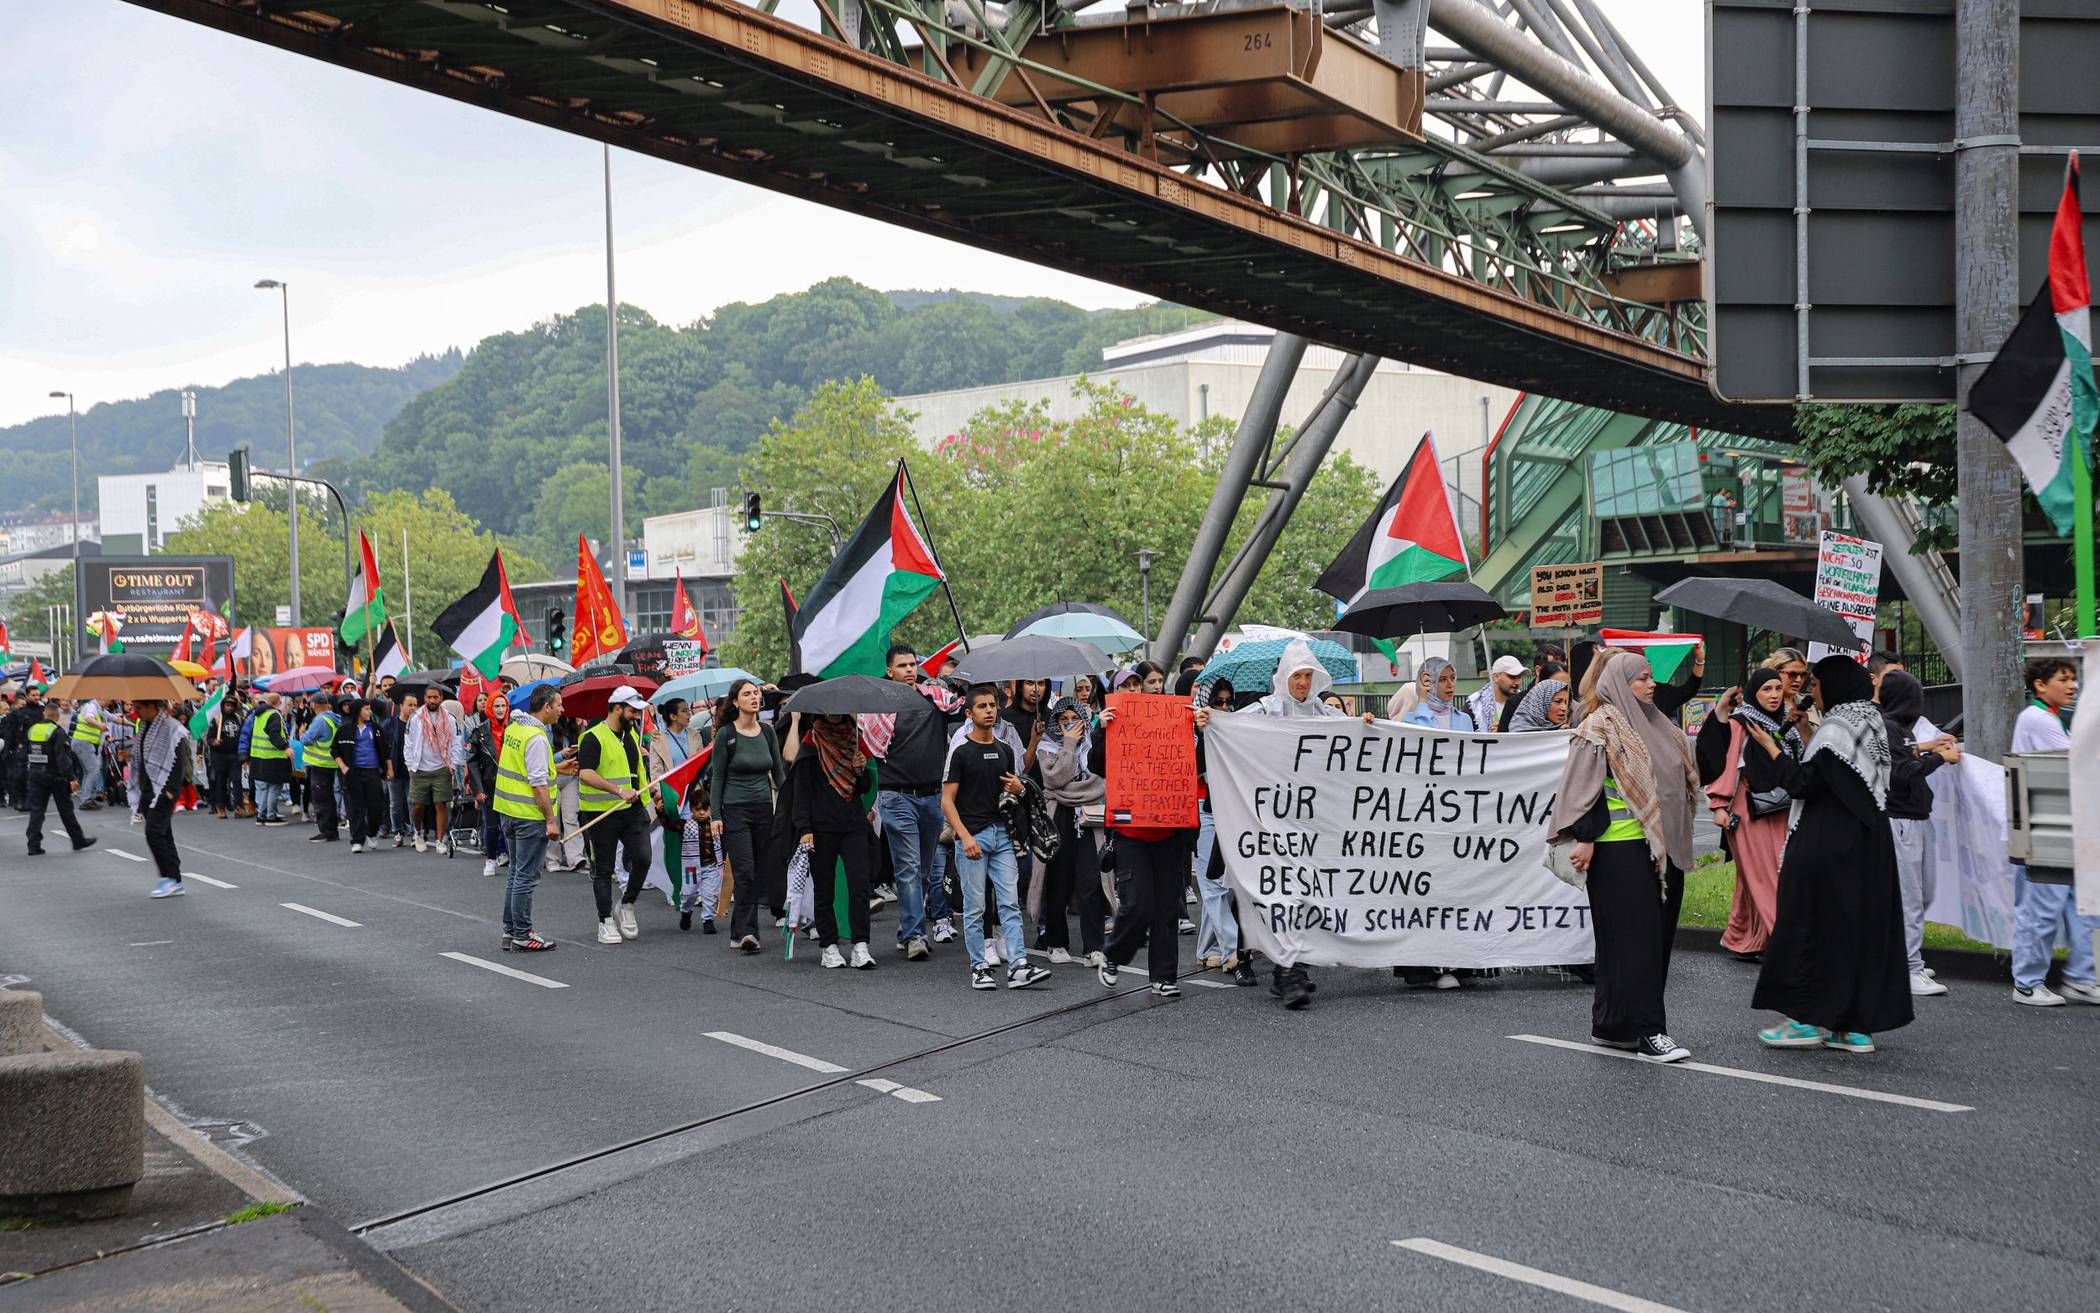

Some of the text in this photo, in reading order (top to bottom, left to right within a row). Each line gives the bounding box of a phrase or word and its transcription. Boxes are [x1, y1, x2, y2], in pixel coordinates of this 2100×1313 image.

[1244, 33, 1272, 51] 264
[1821, 551, 1863, 570] NICHT SO
[1865, 548, 1879, 560] IST
[127, 574, 195, 587] TIME OUT
[1536, 567, 1597, 582] YOU KNOW WHAT
[130, 588, 185, 596] RESTAURANT
[128, 616, 133, 624] 2
[149, 615, 189, 625] Wuppertal
[117, 633, 201, 643] www.cafetimeoutfo
[306, 632, 330, 648] SPD
[663, 641, 692, 650] WENN
[307, 648, 330, 657] WÄHLEN
[1123, 700, 1194, 720] IT IS NOT
[1118, 724, 1127, 738] A
[1121, 742, 1186, 761] IF 1 SIDE
[1294, 735, 1498, 776] FREIHEIT
[1120, 761, 1195, 777] HAS THE GUN
[1117, 778, 1190, 793] & THE OTHER
[1120, 793, 1195, 811] IS PRAYING
[1255, 783, 1557, 825] FÜR PALÄSTINA
[1238, 830, 1520, 863] GEGEN KRIEG UND
[1259, 865, 1432, 898] BESATZUNG
[1364, 906, 1493, 932] SCHAFFEN
[1505, 905, 1591, 933] JETZT
